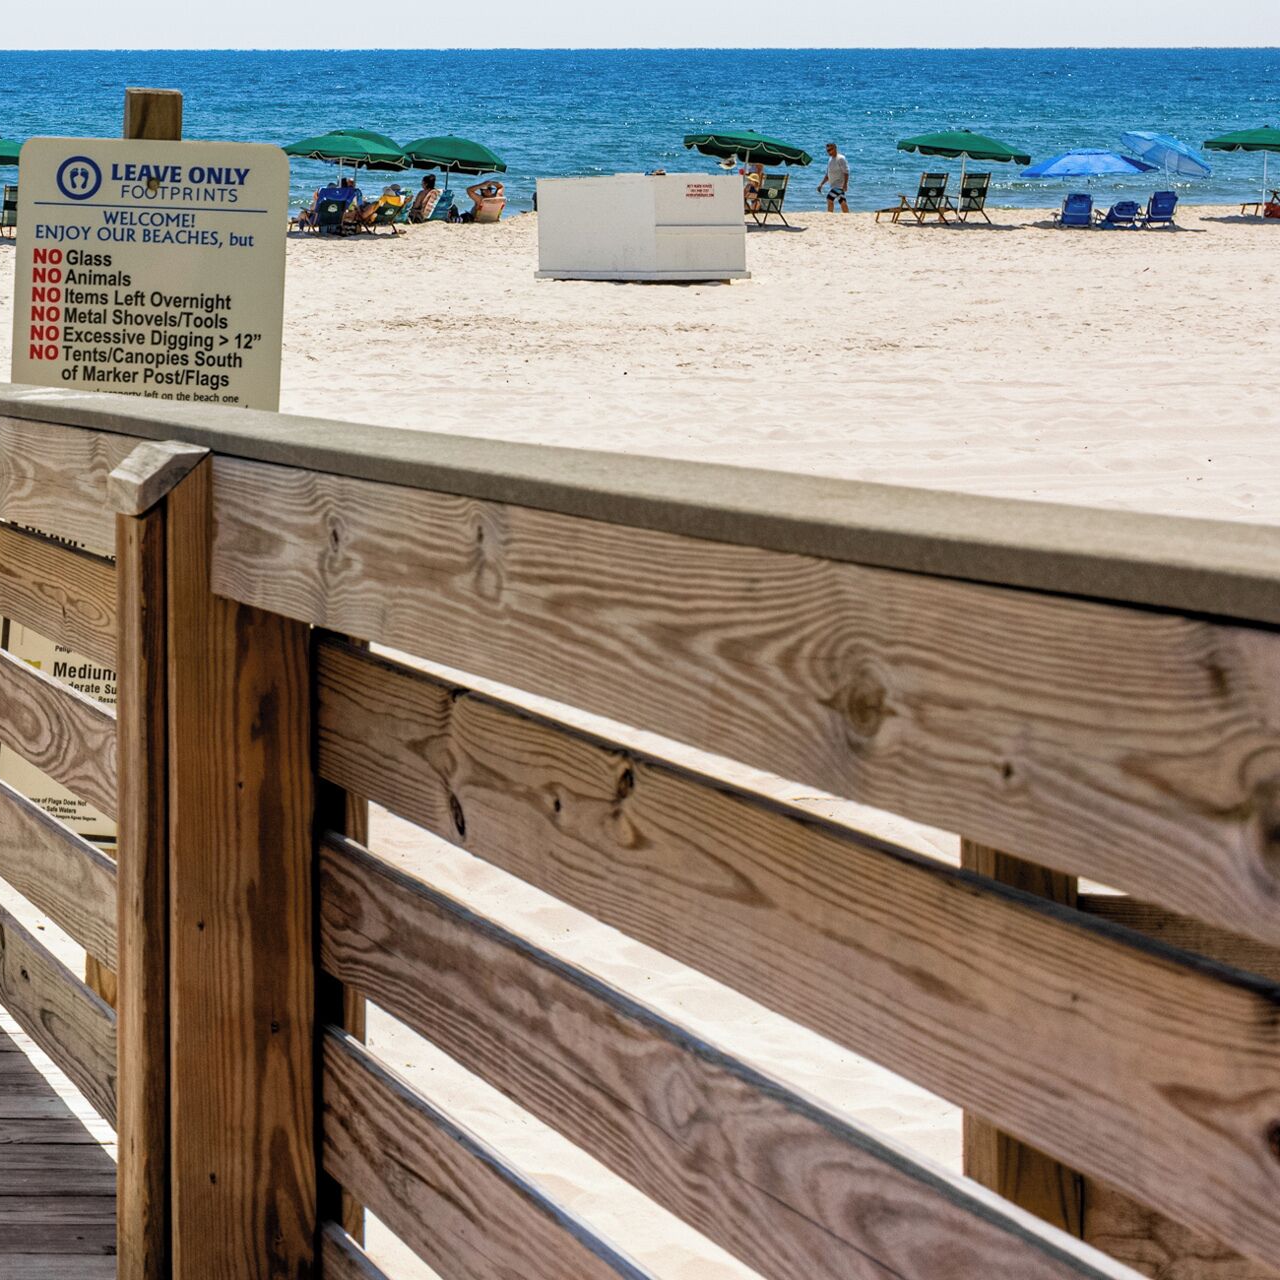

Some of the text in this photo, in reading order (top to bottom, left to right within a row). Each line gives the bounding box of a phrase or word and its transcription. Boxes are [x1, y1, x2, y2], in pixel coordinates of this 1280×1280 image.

[111, 164, 250, 185] LEAVE ONLY
[121, 184, 238, 203] FOOTPRINTS
[103, 210, 196, 228] WELCOME!
[35, 224, 254, 248] ENJOY OUR BEACHES, but
[33, 248, 112, 267] NO Glass
[32, 268, 131, 286] NO Animals
[32, 286, 231, 313] NO Items Left Overnight
[31, 306, 228, 329] NO Metal Shovels/Tools
[30, 325, 60, 341] NO
[63, 326, 145, 344] Excessive
[150, 330, 214, 352] Digging
[30, 344, 242, 368] NO Tents/Canopies South
[62, 365, 230, 390] of Marker Post/Flags
[144, 390, 158, 398] left
[161, 392, 173, 400] on
[176, 392, 190, 401] the
[193, 392, 220, 402] beach
[222, 395, 239, 403] one
[53, 661, 117, 681] Medium
